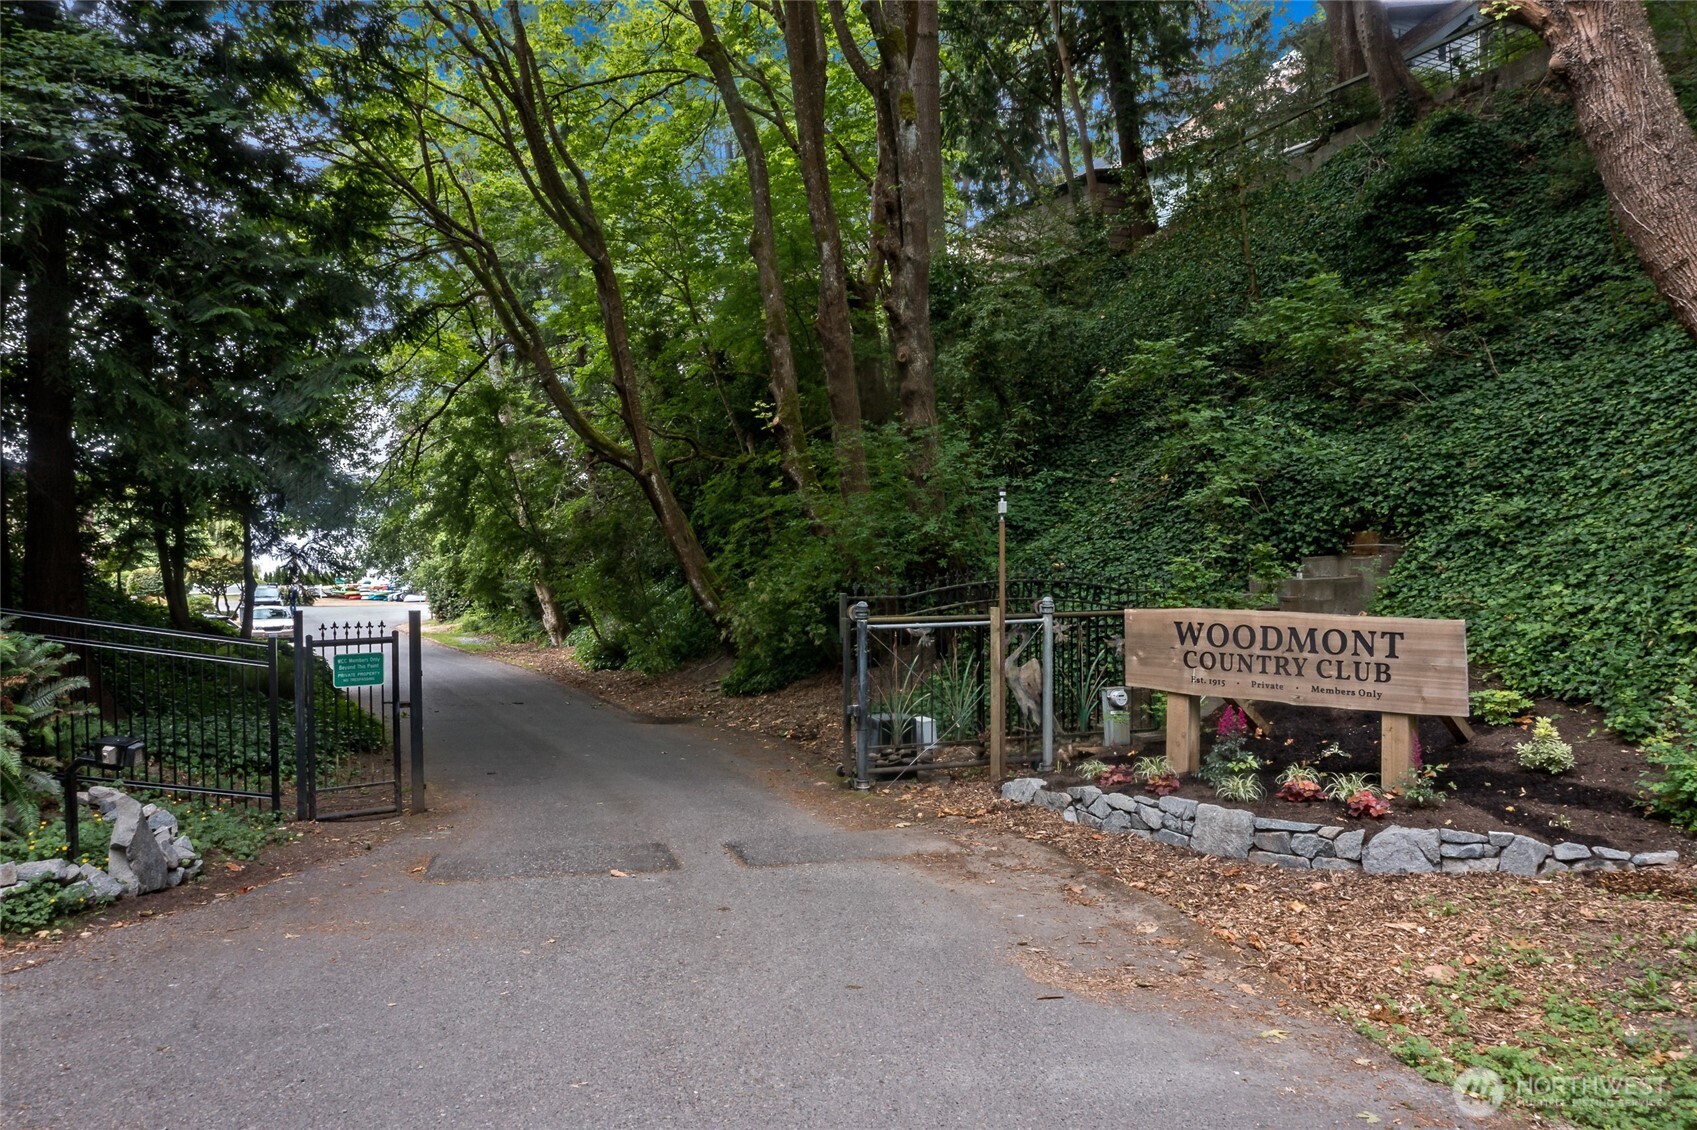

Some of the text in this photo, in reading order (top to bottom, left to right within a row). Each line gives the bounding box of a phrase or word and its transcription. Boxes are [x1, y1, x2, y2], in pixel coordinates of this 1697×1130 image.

[1173, 621, 1405, 659] WOODMONT
[1183, 650, 1392, 683] COUNTRY CLUB
[1191, 676, 1383, 700] Est. 1915 Private Members Only
